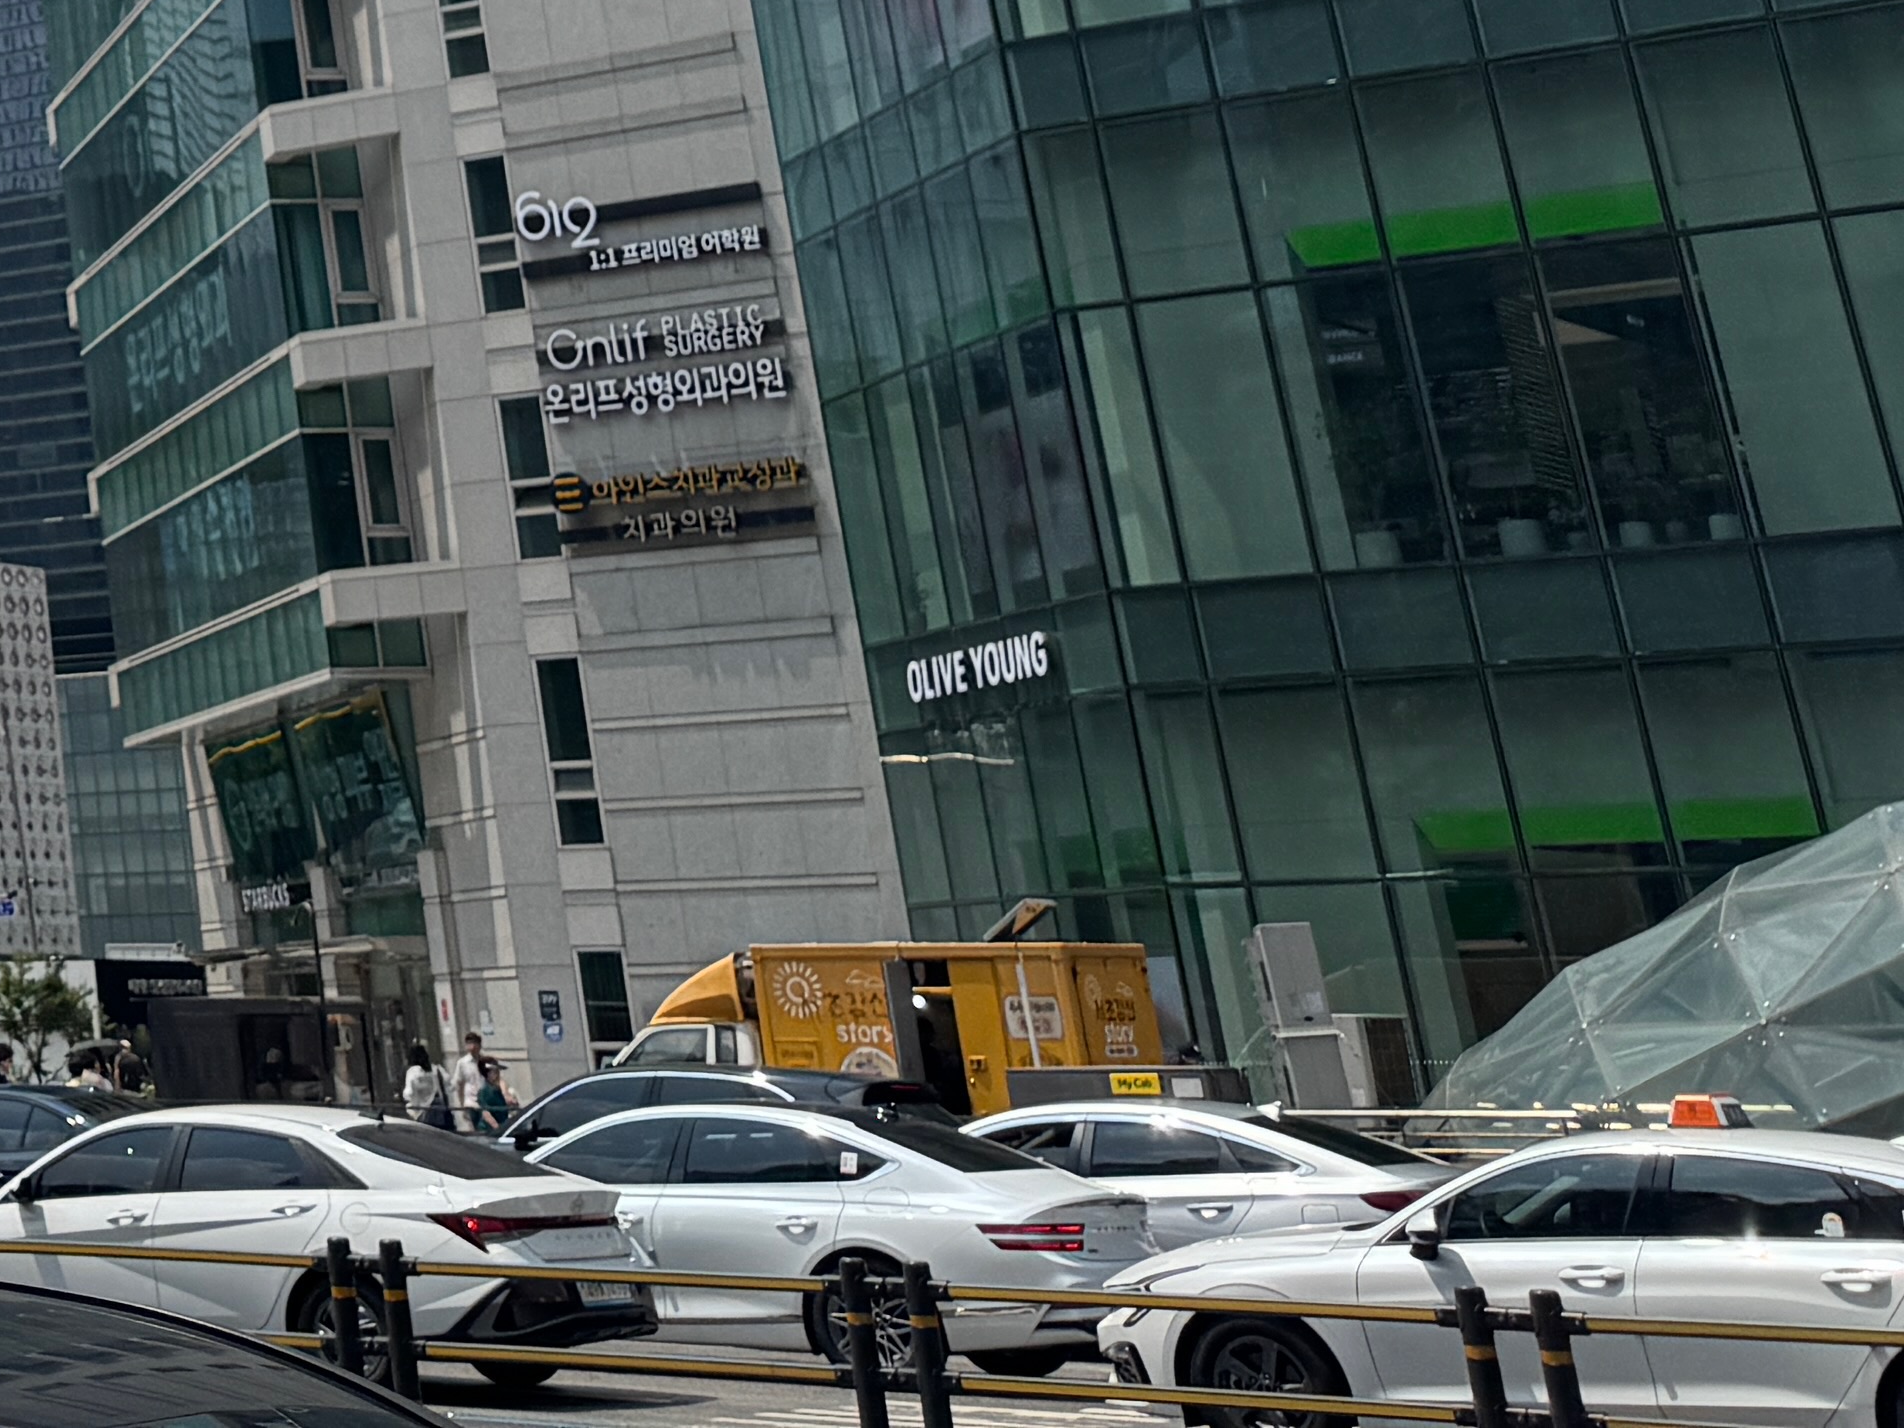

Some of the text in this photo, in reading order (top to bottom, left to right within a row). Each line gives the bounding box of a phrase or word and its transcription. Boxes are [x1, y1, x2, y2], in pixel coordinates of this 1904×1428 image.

[515, 191, 600, 249] 612
[589, 224, 761, 271] 1:1 프리미엄 어학원
[661, 304, 762, 336] PLASTIC
[664, 324, 765, 358] SURGERY
[544, 356, 787, 424] 온리프성형외과의원
[623, 504, 737, 542] 치과의원
[906, 630, 1048, 703] OLIVE YOUNG
